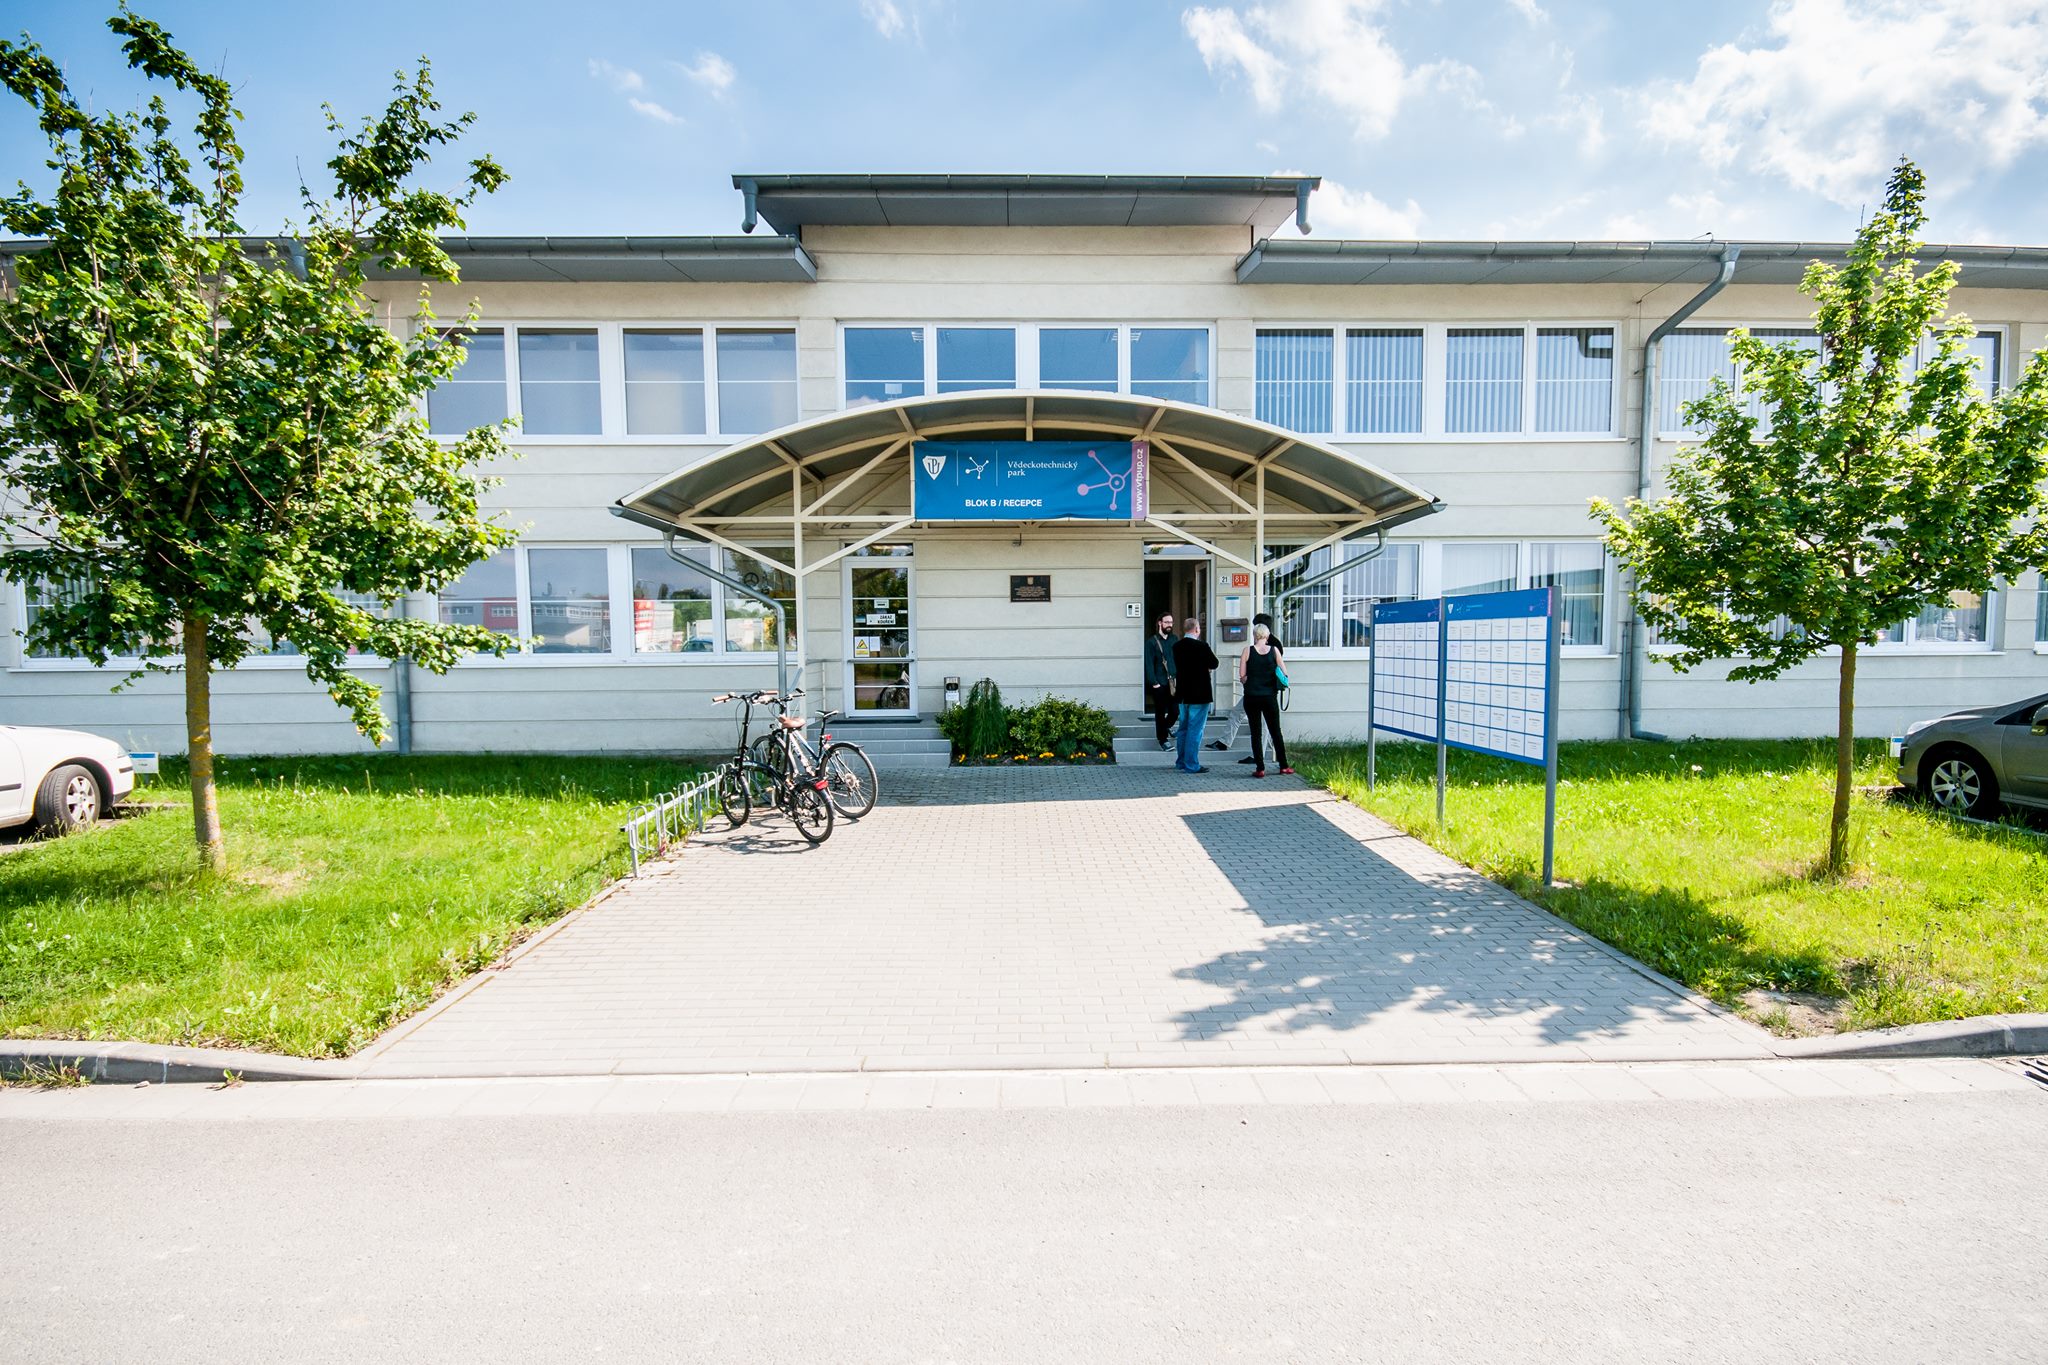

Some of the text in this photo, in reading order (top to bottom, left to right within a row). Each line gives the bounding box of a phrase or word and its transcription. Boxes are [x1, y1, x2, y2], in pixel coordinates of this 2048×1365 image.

[1007, 461, 1079, 470] Vědeckotechnický
[1007, 470, 1026, 478] park
[1136, 448, 1144, 512] www.vtpup.cz
[965, 499, 988, 507] BLOK
[990, 499, 997, 507] B
[1003, 499, 1043, 507] RECEPCE
